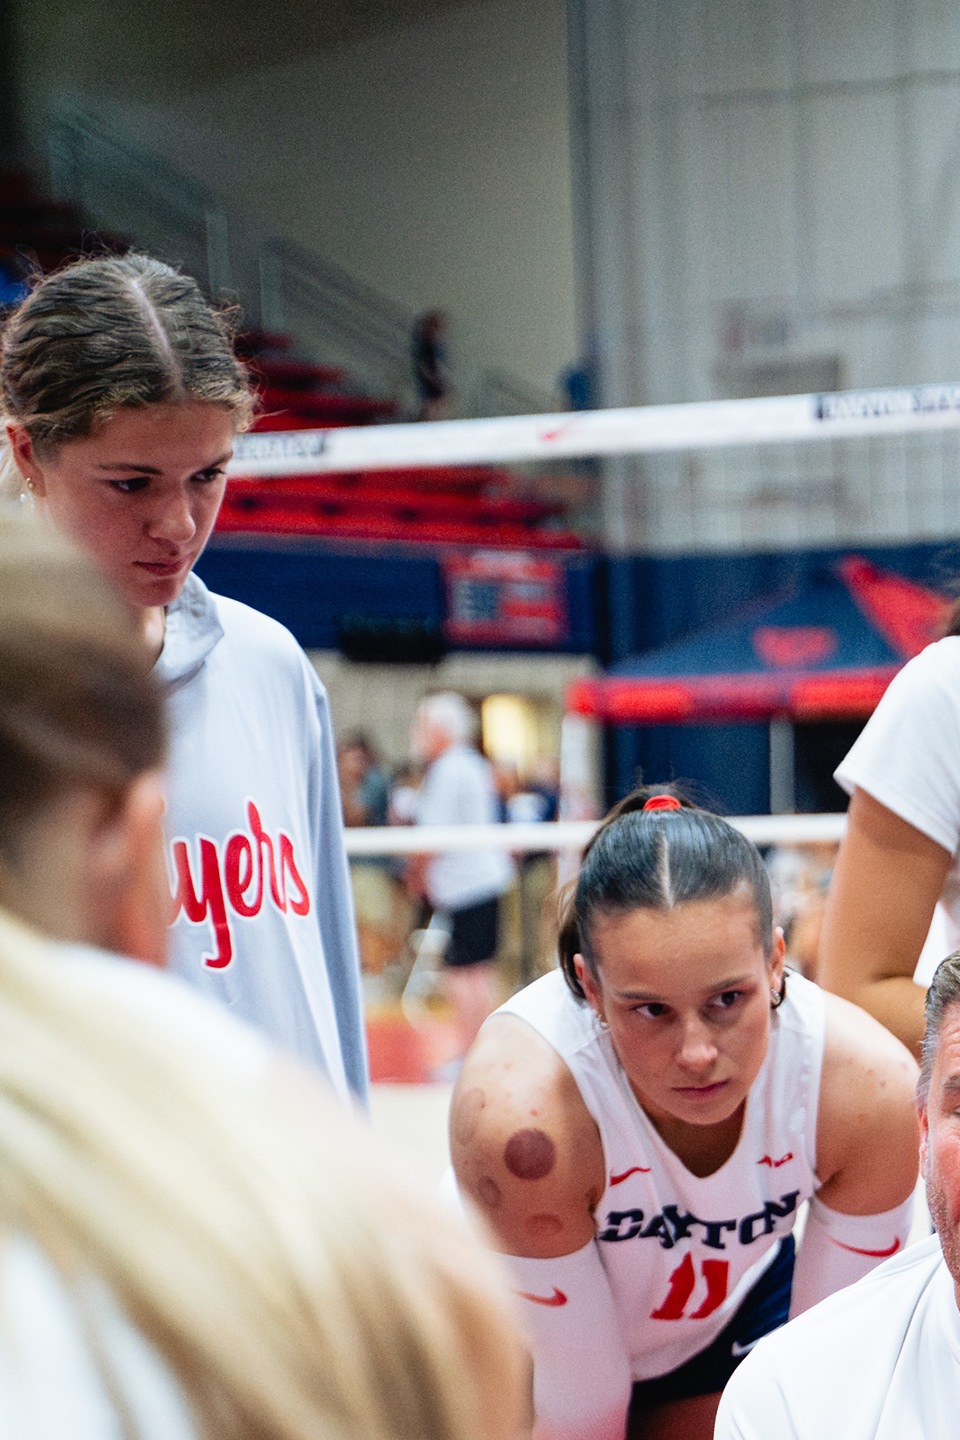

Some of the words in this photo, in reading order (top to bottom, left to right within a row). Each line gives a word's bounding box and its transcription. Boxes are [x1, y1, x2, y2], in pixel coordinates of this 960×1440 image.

[169, 798, 312, 971] yers
[599, 1188, 801, 1249] DAYTON
[650, 1250, 730, 1320] 11
